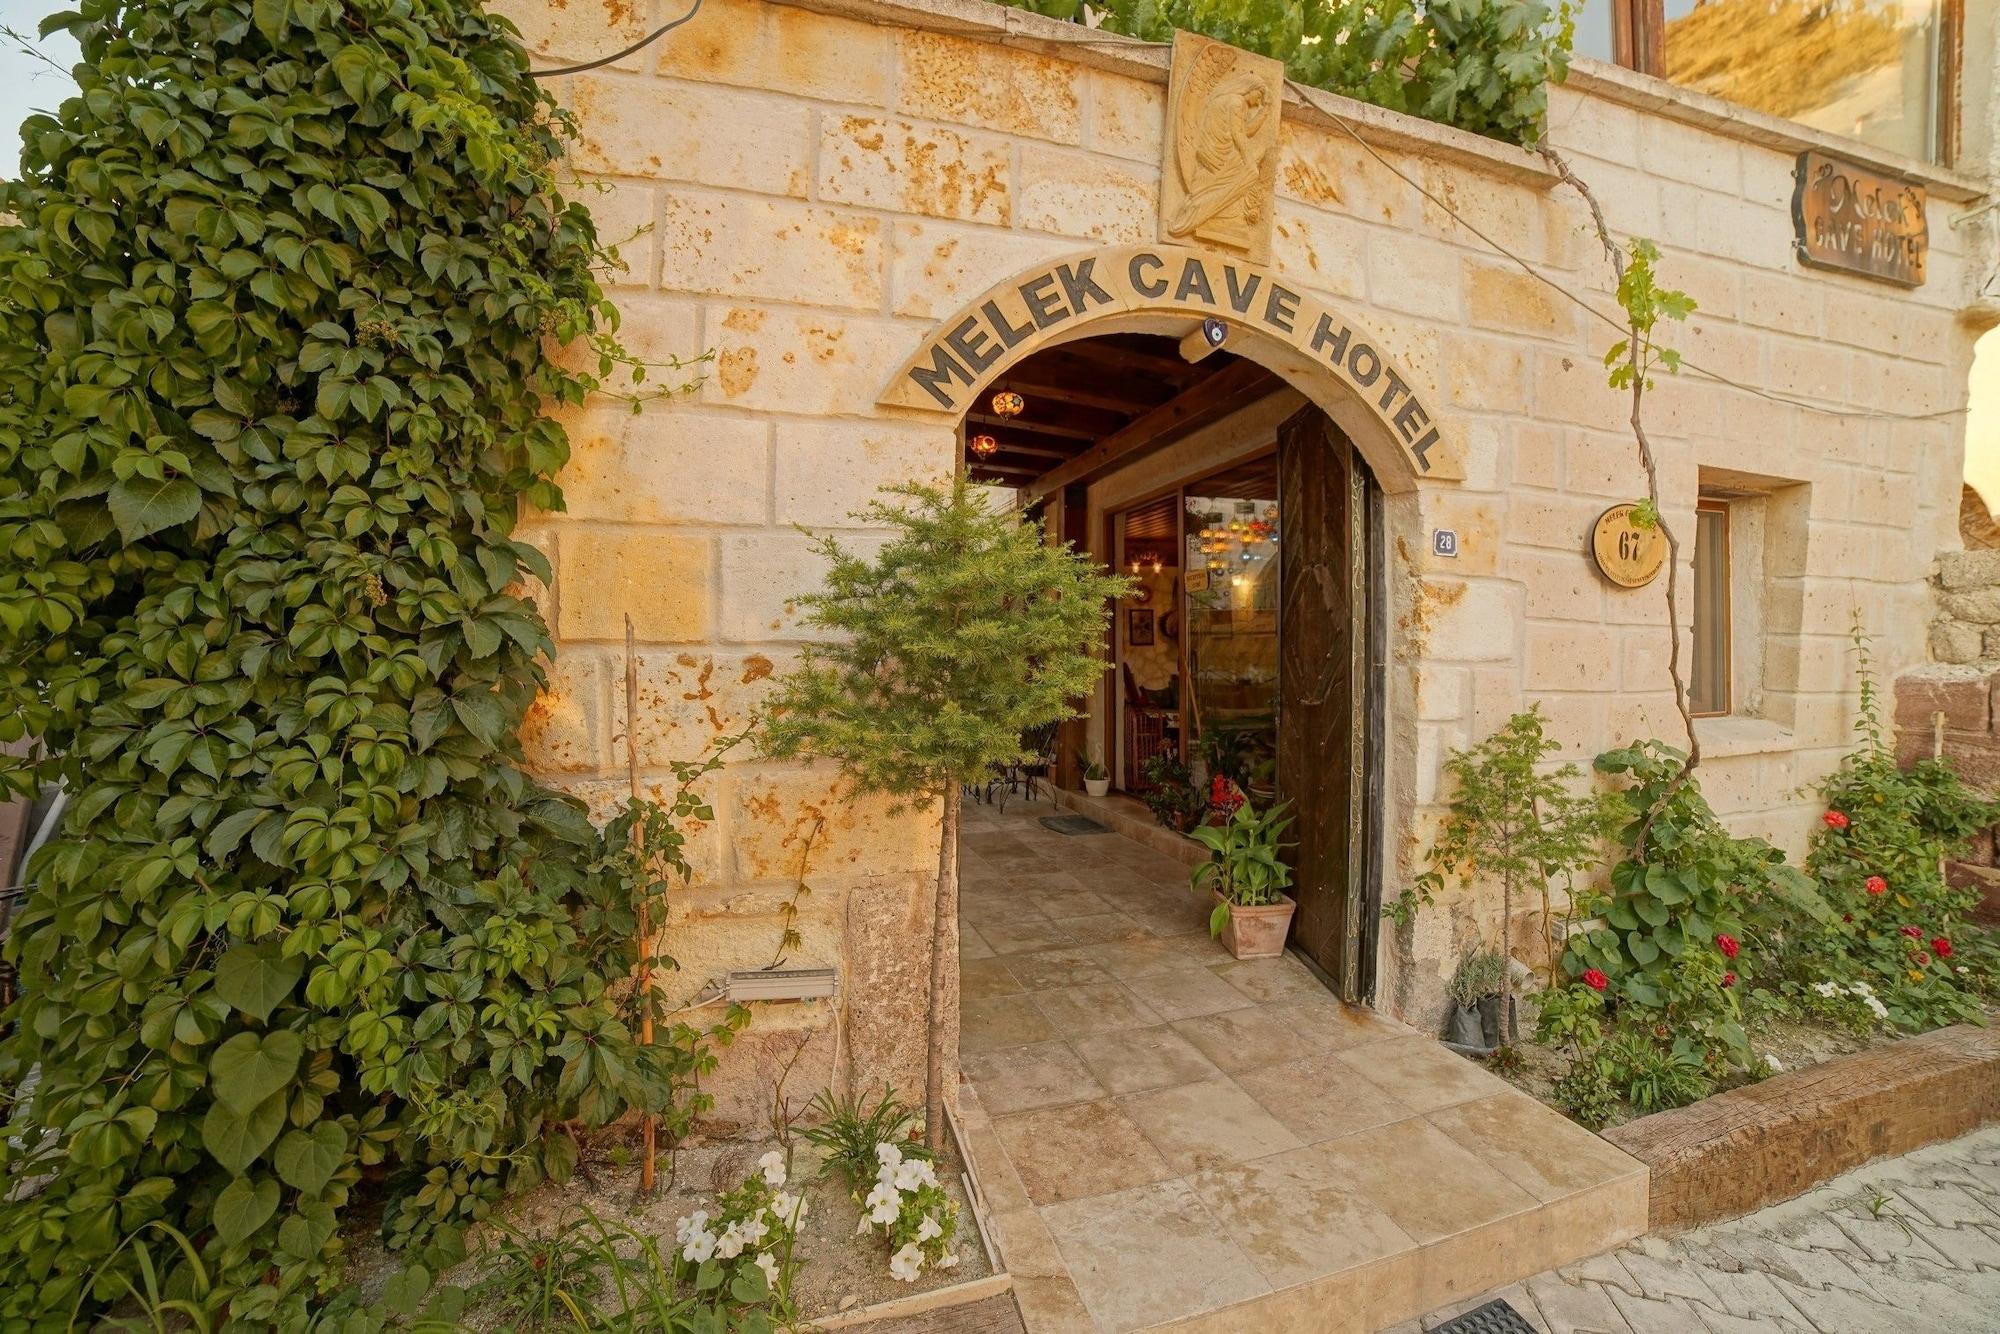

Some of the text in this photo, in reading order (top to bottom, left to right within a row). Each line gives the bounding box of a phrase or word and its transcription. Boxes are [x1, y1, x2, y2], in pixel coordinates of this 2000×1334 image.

[1814, 216, 1922, 269] CAVE HOTEL
[907, 252, 1441, 474] MELEK CAVE HOTEL
[1439, 535, 1452, 550] 28
[1618, 530, 1641, 561] 67
